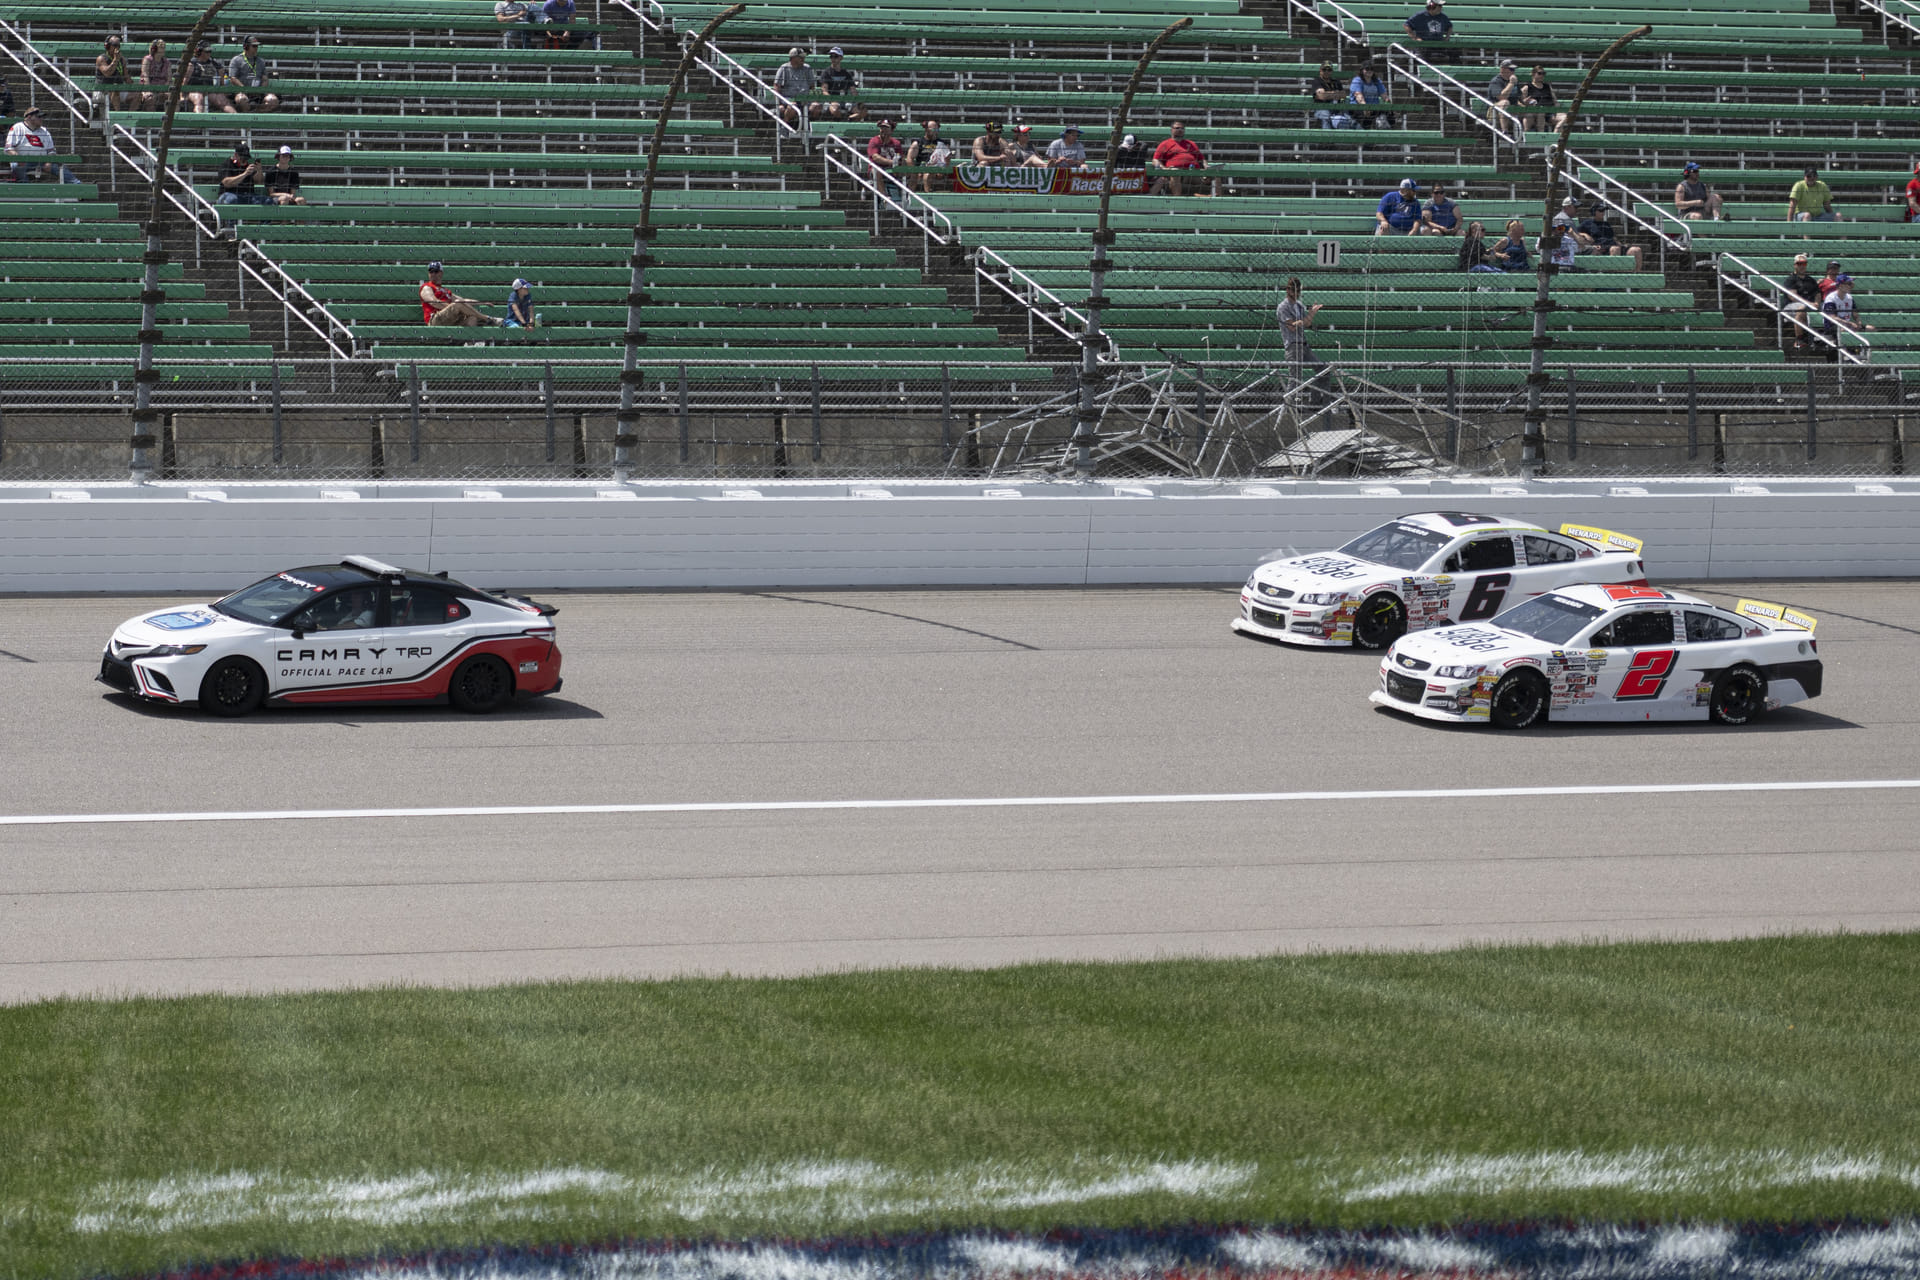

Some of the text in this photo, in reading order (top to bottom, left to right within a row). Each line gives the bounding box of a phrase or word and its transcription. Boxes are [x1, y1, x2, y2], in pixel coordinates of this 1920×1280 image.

[1071, 176, 1144, 191] Race Fans!
[1322, 242, 1336, 265] 11
[1567, 527, 1602, 541] MENARDS
[1607, 535, 1639, 550] MENARDS
[1459, 572, 1512, 621] 6
[1744, 603, 1780, 618] MENARDS
[1784, 613, 1813, 628] MENARDS
[277, 647, 432, 661] CAMRY TRD
[281, 667, 393, 677] OFFICIAL PACE CAR
[1613, 648, 1680, 702] 2
